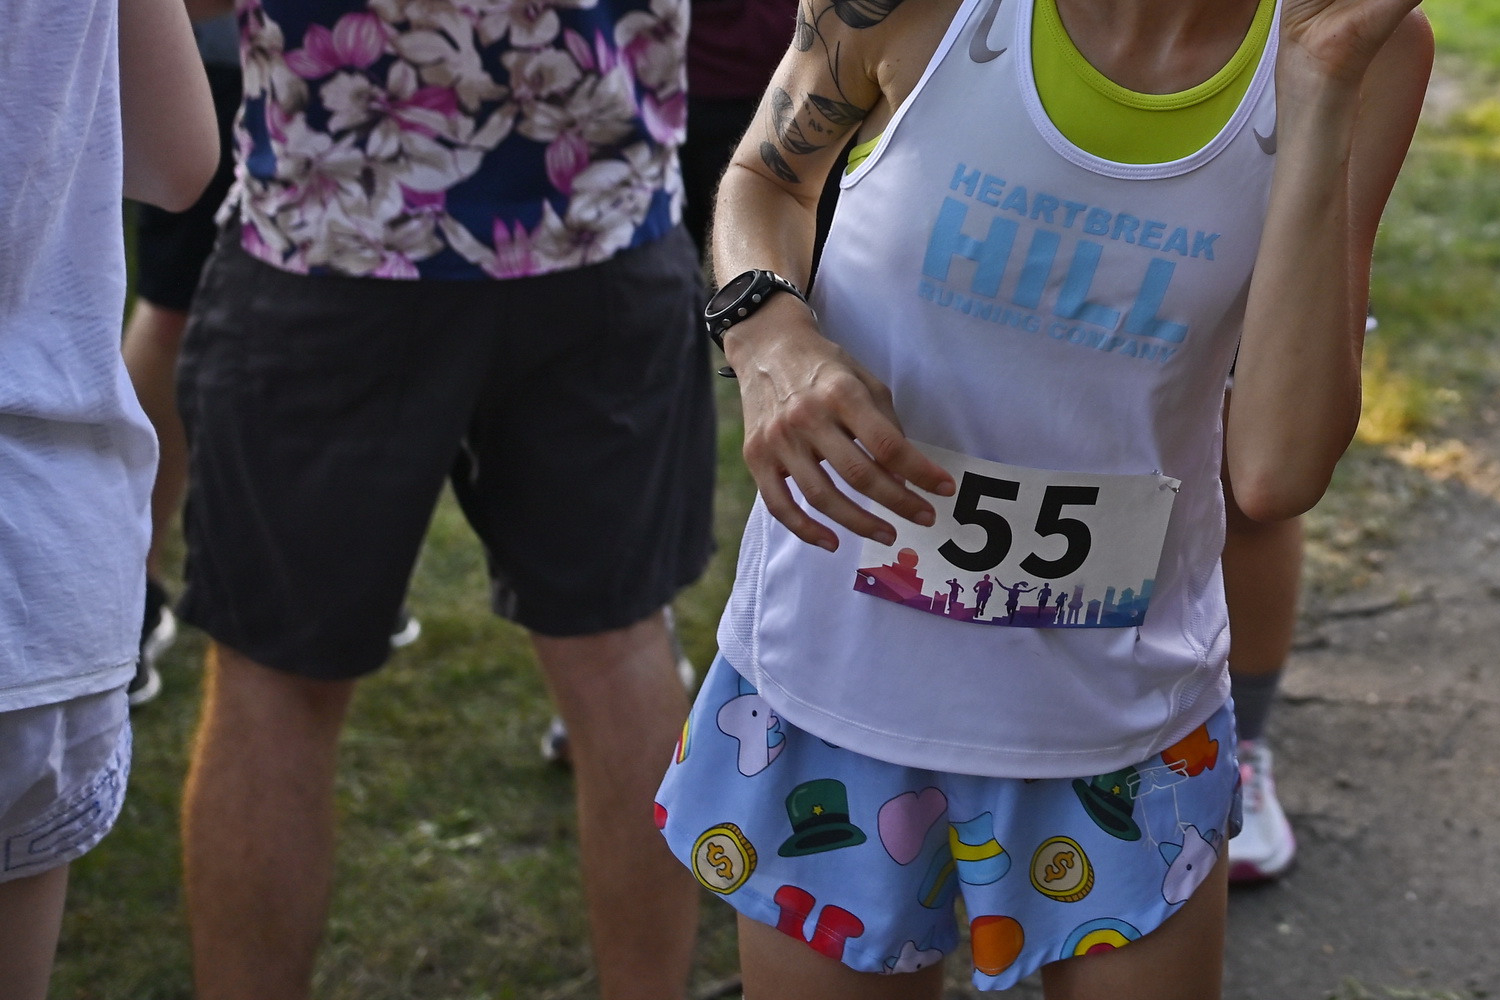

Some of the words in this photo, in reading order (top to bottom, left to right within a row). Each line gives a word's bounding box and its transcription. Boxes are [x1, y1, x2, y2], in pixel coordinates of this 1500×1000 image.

[949, 162, 1221, 261] HEARTBREAK
[921, 196, 1189, 344] HILL
[918, 281, 1042, 334] RUNNING
[1047, 321, 1178, 364] COMPANY
[937, 470, 1099, 579] 55
